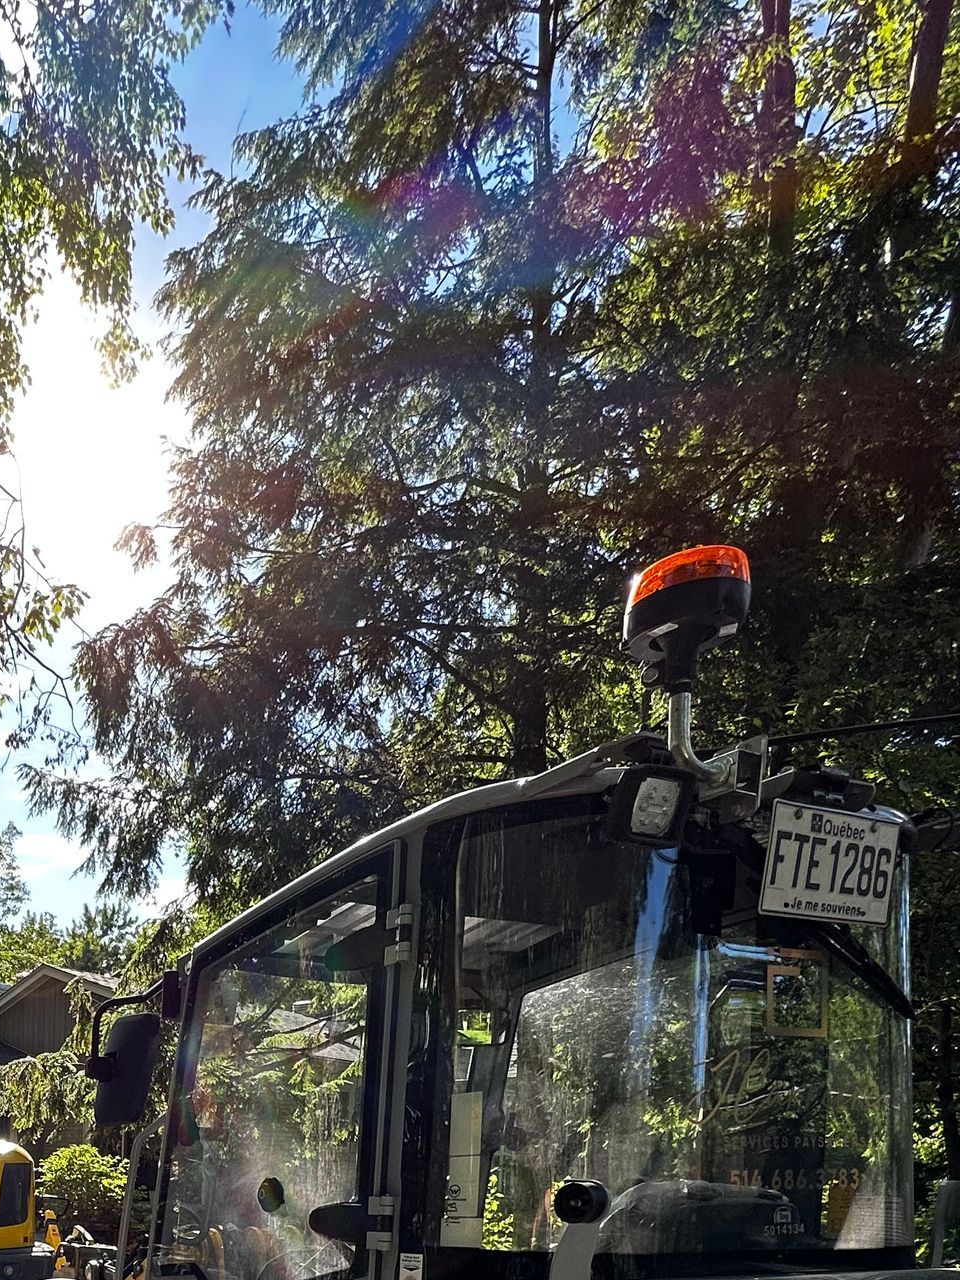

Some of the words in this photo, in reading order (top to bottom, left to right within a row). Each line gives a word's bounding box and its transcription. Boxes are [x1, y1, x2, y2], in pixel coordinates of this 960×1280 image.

[823, 819, 866, 840] Québec
[769, 830, 892, 899] FTE1286
[791, 897, 802, 909] Je
[805, 901, 819, 912] me
[821, 902, 861, 917] souviens
[794, 1136, 867, 1149] PAYSERS
[763, 1223, 805, 1237] 5014134
